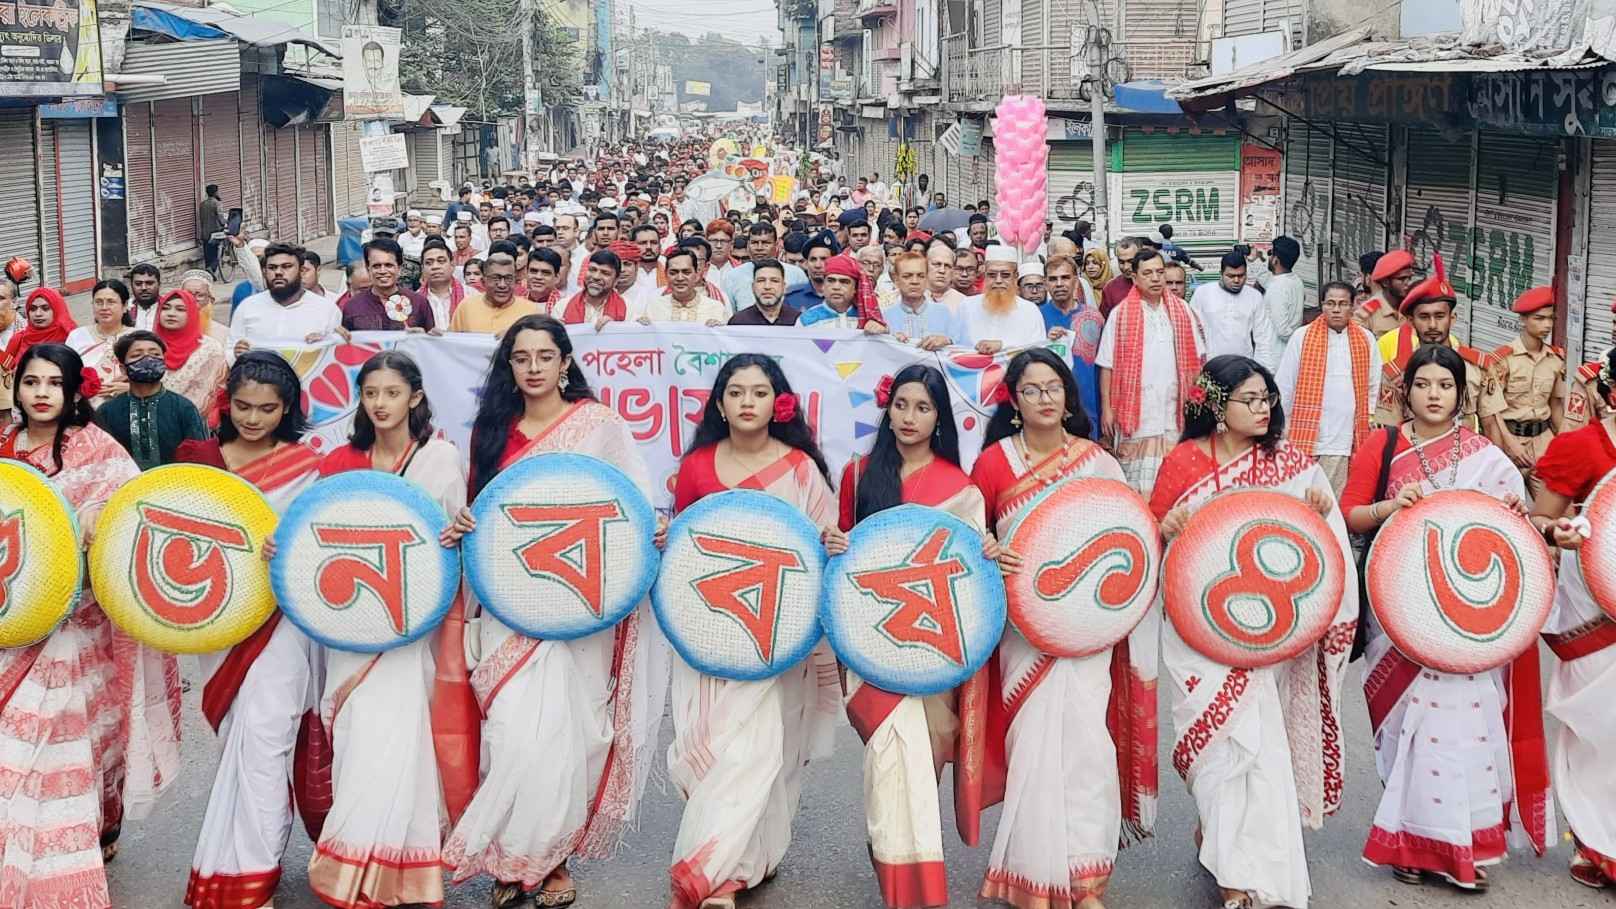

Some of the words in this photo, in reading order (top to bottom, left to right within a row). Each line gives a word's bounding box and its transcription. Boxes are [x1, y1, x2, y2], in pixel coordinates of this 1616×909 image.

[1130, 187, 1219, 223] ZSRM
[1447, 223, 1534, 309] ZSRM
[581, 348, 665, 376] পহেলা
[129, 501, 253, 631] ভ
[311, 522, 427, 637] ন
[499, 499, 629, 620] ব
[689, 528, 808, 666] ব
[1034, 526, 1151, 611] ১
[1201, 519, 1325, 651] ৪
